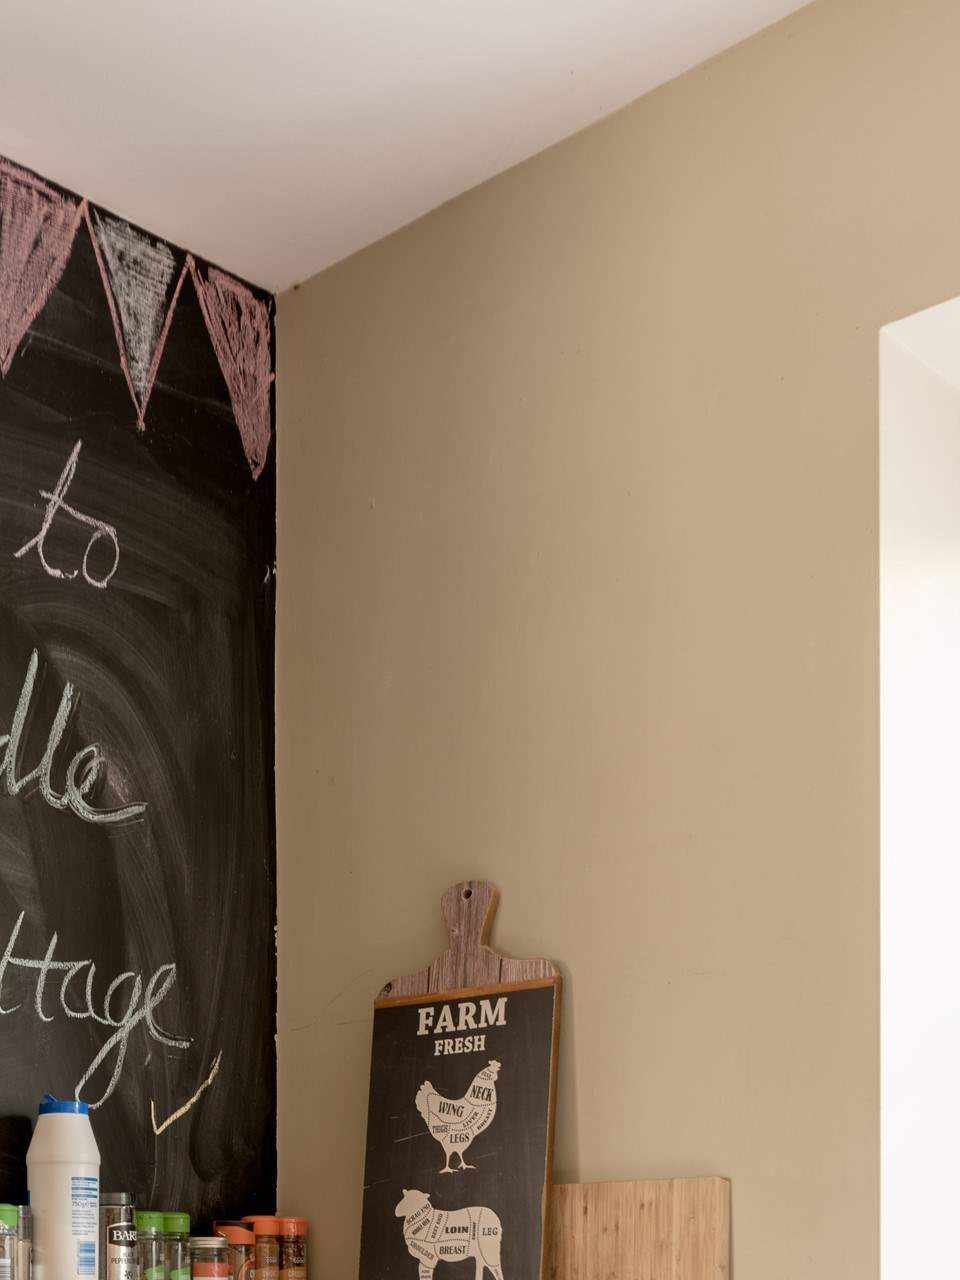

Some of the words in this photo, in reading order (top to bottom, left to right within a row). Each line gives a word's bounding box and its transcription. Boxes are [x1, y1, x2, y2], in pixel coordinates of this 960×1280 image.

[14, 439, 119, 588] to
[417, 997, 508, 1036] FARM
[434, 1034, 486, 1056] FRESH
[469, 1084, 494, 1102] NECK
[438, 1101, 465, 1118] WING
[450, 1132, 470, 1144] LEGS
[444, 1226, 469, 1234] LOIN
[482, 1227, 498, 1236] LEG
[439, 1245, 466, 1255] BREAST
